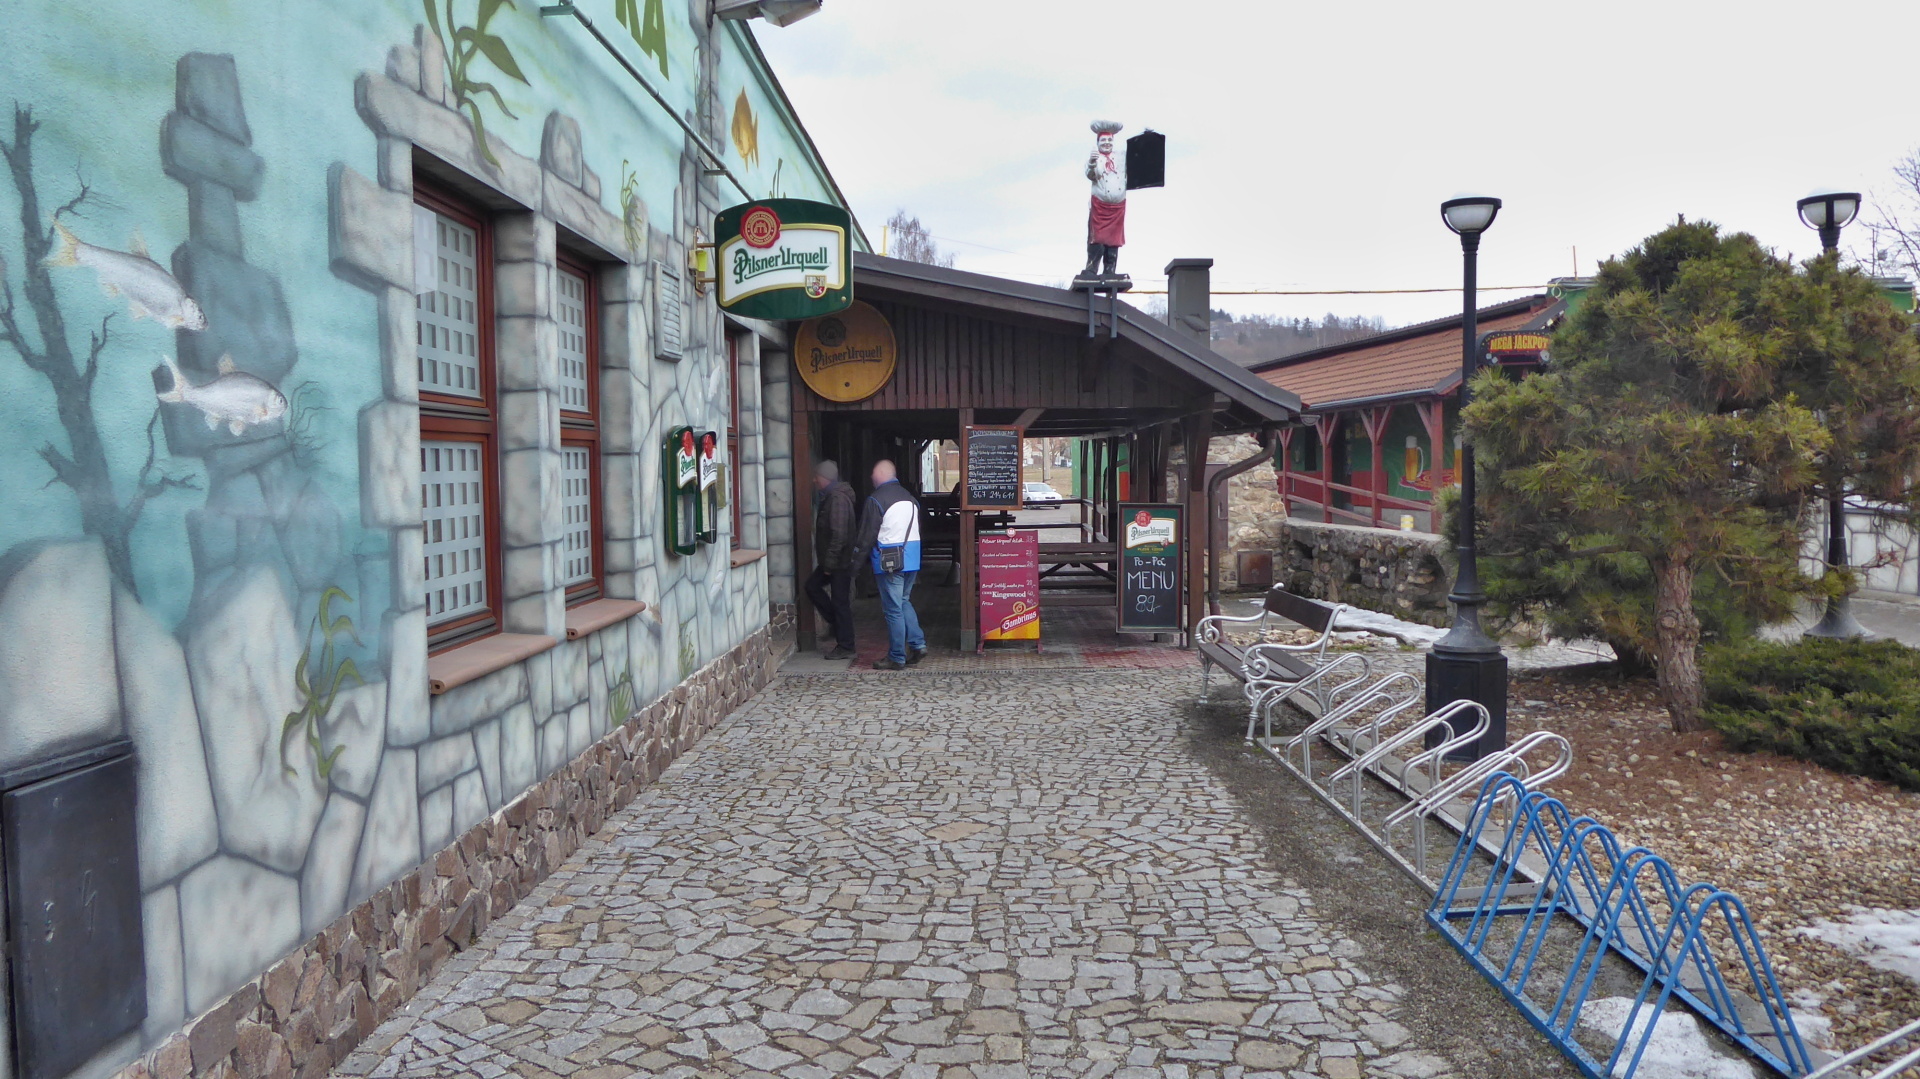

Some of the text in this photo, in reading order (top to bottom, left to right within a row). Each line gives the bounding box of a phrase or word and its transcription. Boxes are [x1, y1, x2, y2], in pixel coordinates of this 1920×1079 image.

[733, 245, 828, 285] Pilsner Urquell
[1490, 334, 1549, 350] MEGA JACKPOT
[810, 345, 882, 374] Pilsner Urquell
[1134, 556, 1144, 567] Po
[1127, 570, 1175, 590] MENU
[991, 590, 1027, 600] Kingswood
[1001, 610, 1037, 630] Gambrinus
